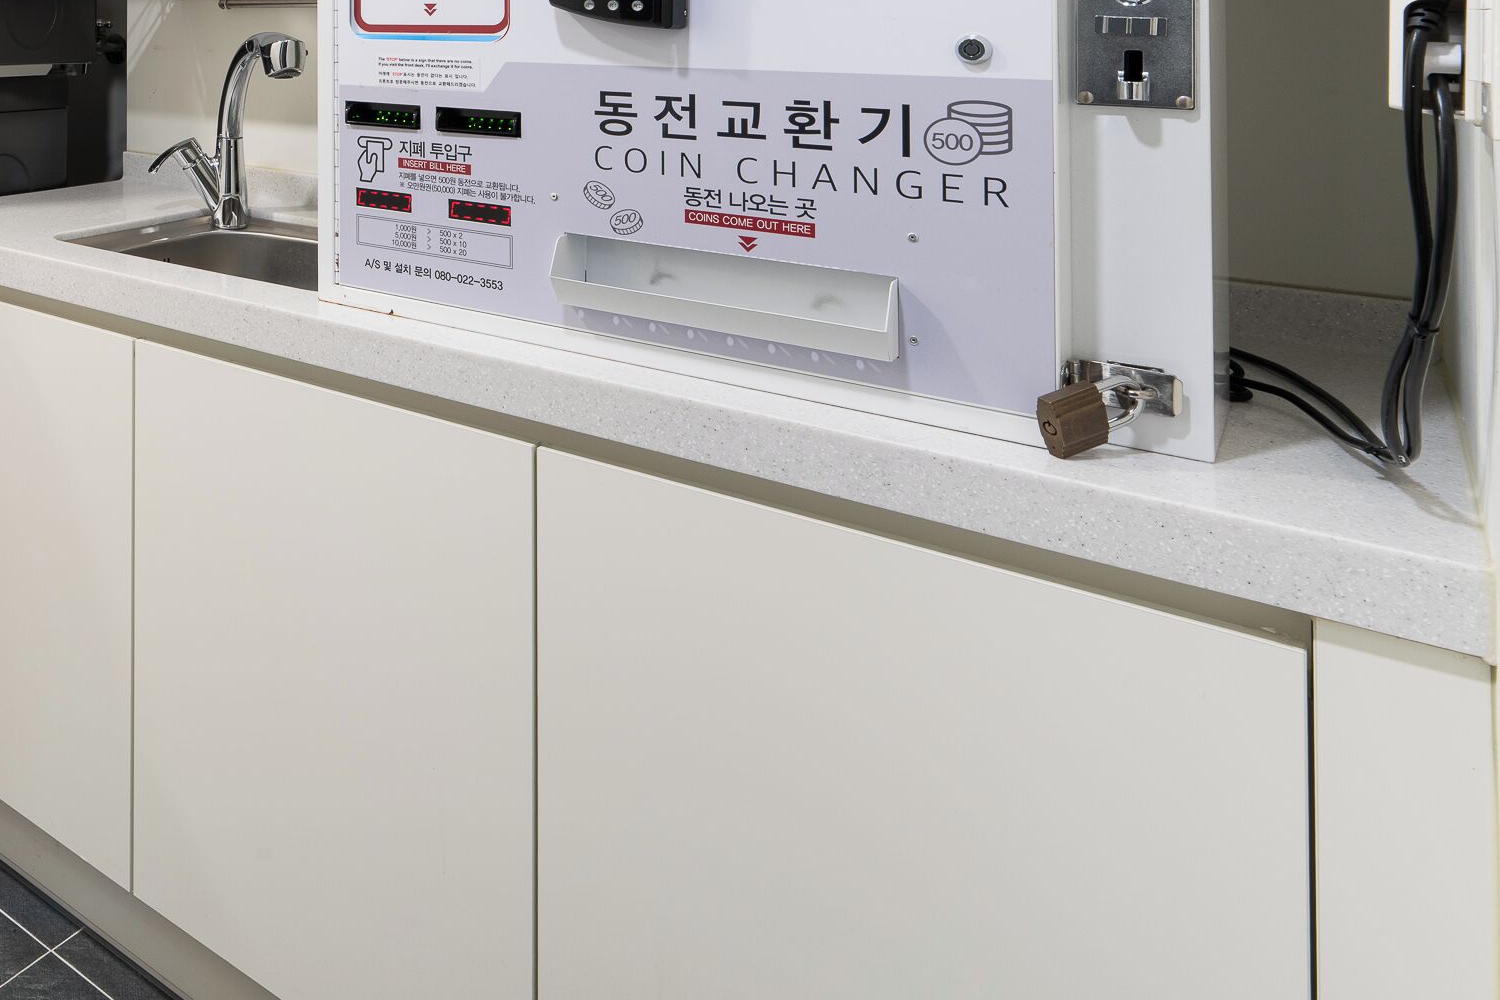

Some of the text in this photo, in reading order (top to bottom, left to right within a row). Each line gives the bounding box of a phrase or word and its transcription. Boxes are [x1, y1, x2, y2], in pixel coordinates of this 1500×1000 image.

[399, 140, 472, 162] 지폐 투입구
[932, 132, 974, 151] 500
[403, 159, 466, 173] INSERT BILL HERE
[594, 145, 1010, 209] COIN CHANGER
[590, 184, 613, 201] 500
[684, 187, 817, 219] 동전 나오는 곳
[614, 212, 636, 226] 500
[688, 211, 811, 235] COINS COME OUT HERE
[364, 258, 503, 290] A/S 및 설치 문의 080-022-3553
